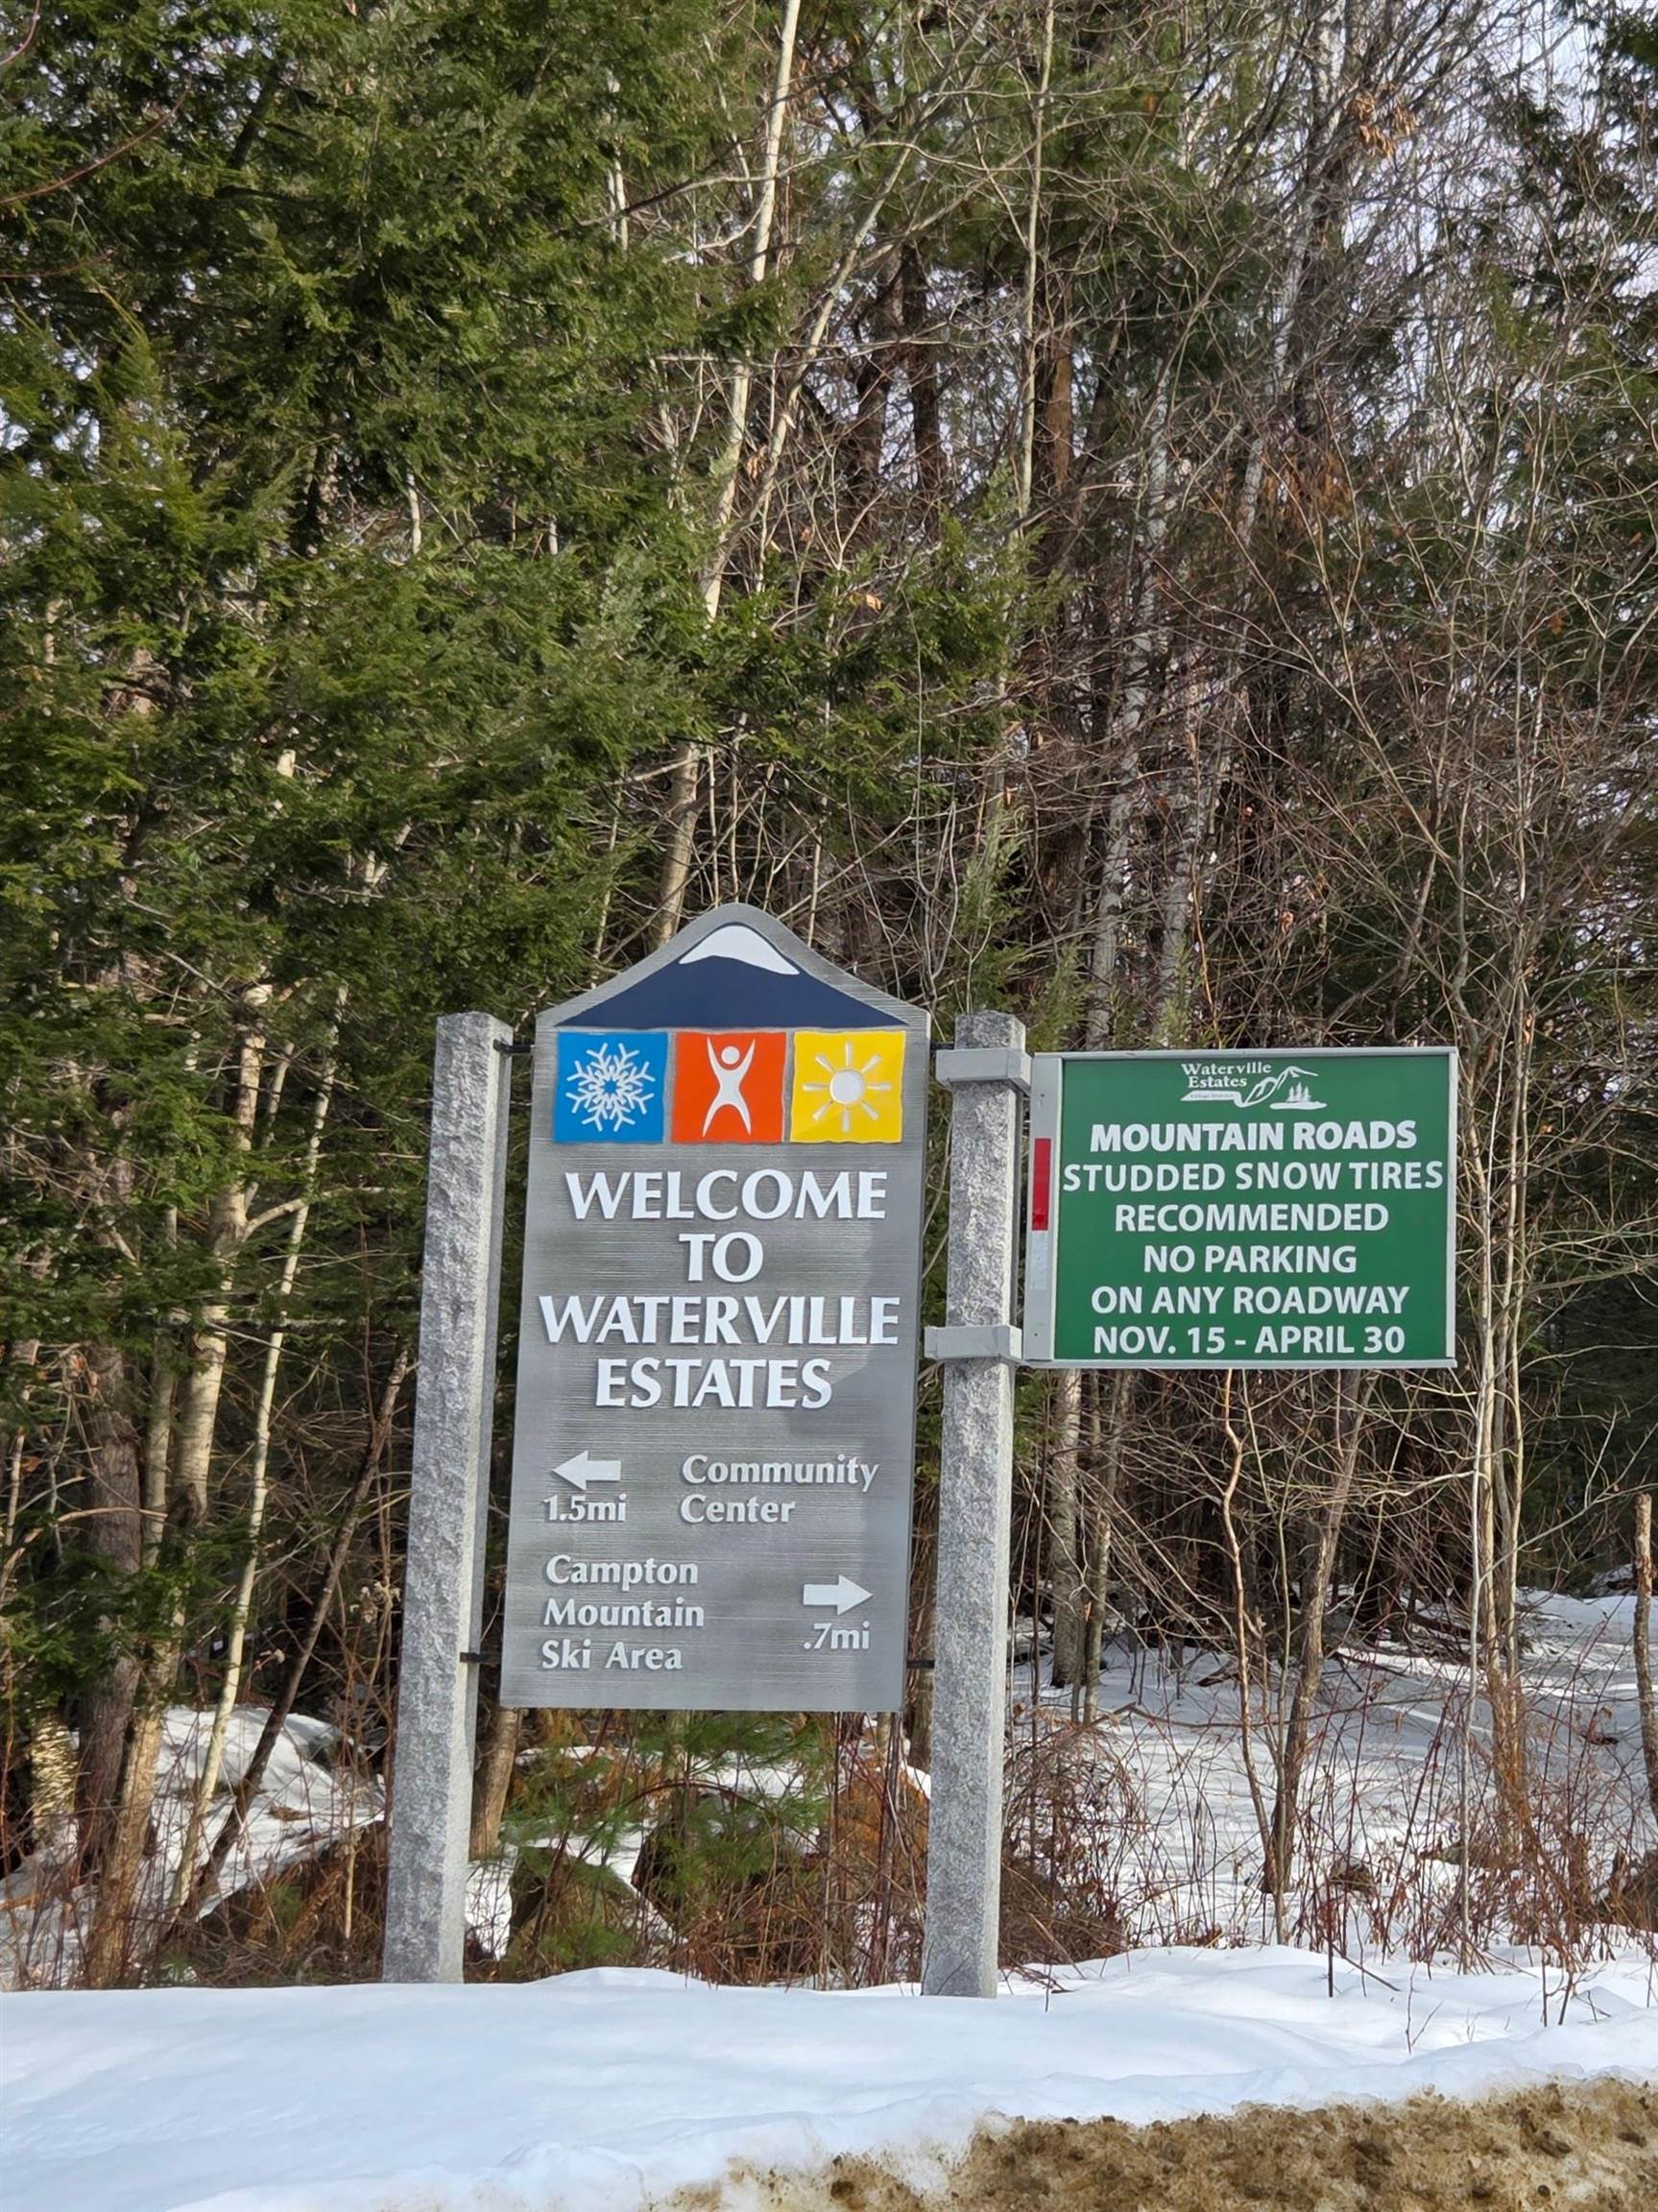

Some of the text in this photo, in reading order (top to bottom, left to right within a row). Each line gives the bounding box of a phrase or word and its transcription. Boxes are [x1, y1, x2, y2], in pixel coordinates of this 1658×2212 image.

[1181, 1061, 1272, 1076] Waterville
[1188, 1075, 1248, 1089] Estates
[1090, 1119, 1417, 1153] MOUNTAIN ROADS
[1063, 1160, 1443, 1192] STUDDED SNOW TIRES
[565, 1168, 887, 1220] WELCOME
[1115, 1203, 1389, 1233] RECOMMENDED
[679, 1232, 763, 1283] TO
[1143, 1244, 1357, 1273] NO PARKING
[1091, 1286, 1410, 1314] ON ANY ROADWAY
[539, 1295, 900, 1344] WATERVILLE
[1093, 1326, 1176, 1355] NOV.
[1188, 1327, 1226, 1354] 15
[1254, 1325, 1355, 1354] APRIL
[1363, 1326, 1406, 1354] 30
[596, 1357, 831, 1408] ESTATES
[683, 1454, 878, 1492] Community
[543, 1493, 627, 1522] 1.5mi
[681, 1493, 796, 1523] Center
[546, 1554, 698, 1592] Campton
[543, 1597, 705, 1626] Mountain
[804, 1621, 870, 1649] .7mi
[542, 1639, 682, 1670] Ski Area
